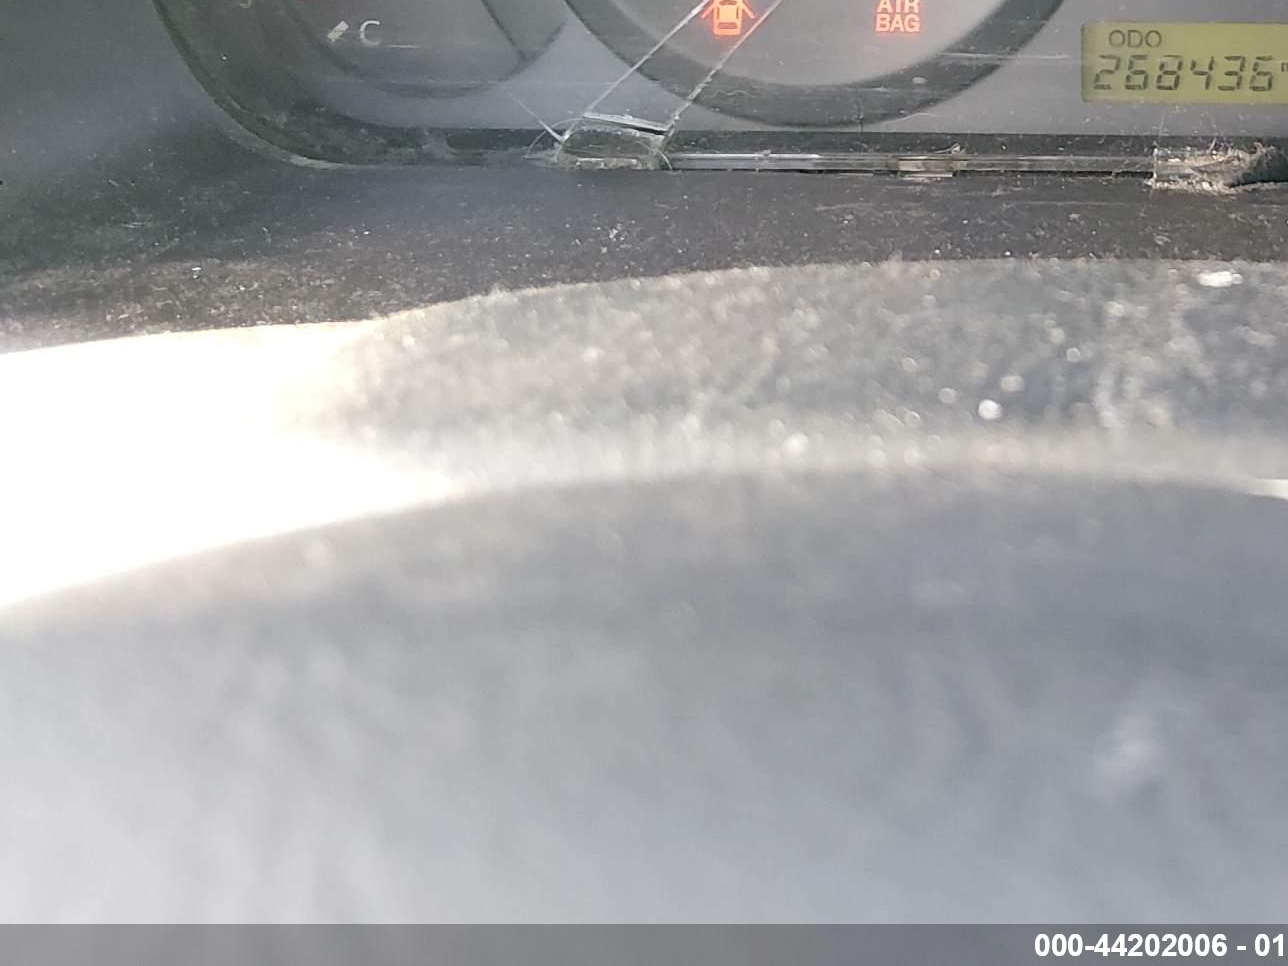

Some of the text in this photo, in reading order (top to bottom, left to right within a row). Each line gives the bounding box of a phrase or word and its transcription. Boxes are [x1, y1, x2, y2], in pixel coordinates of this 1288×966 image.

[359, 20, 381, 45] C
[875, 14, 921, 33] BAG
[1108, 29, 1163, 49] ODO
[1092, 54, 1275, 92] 268436
